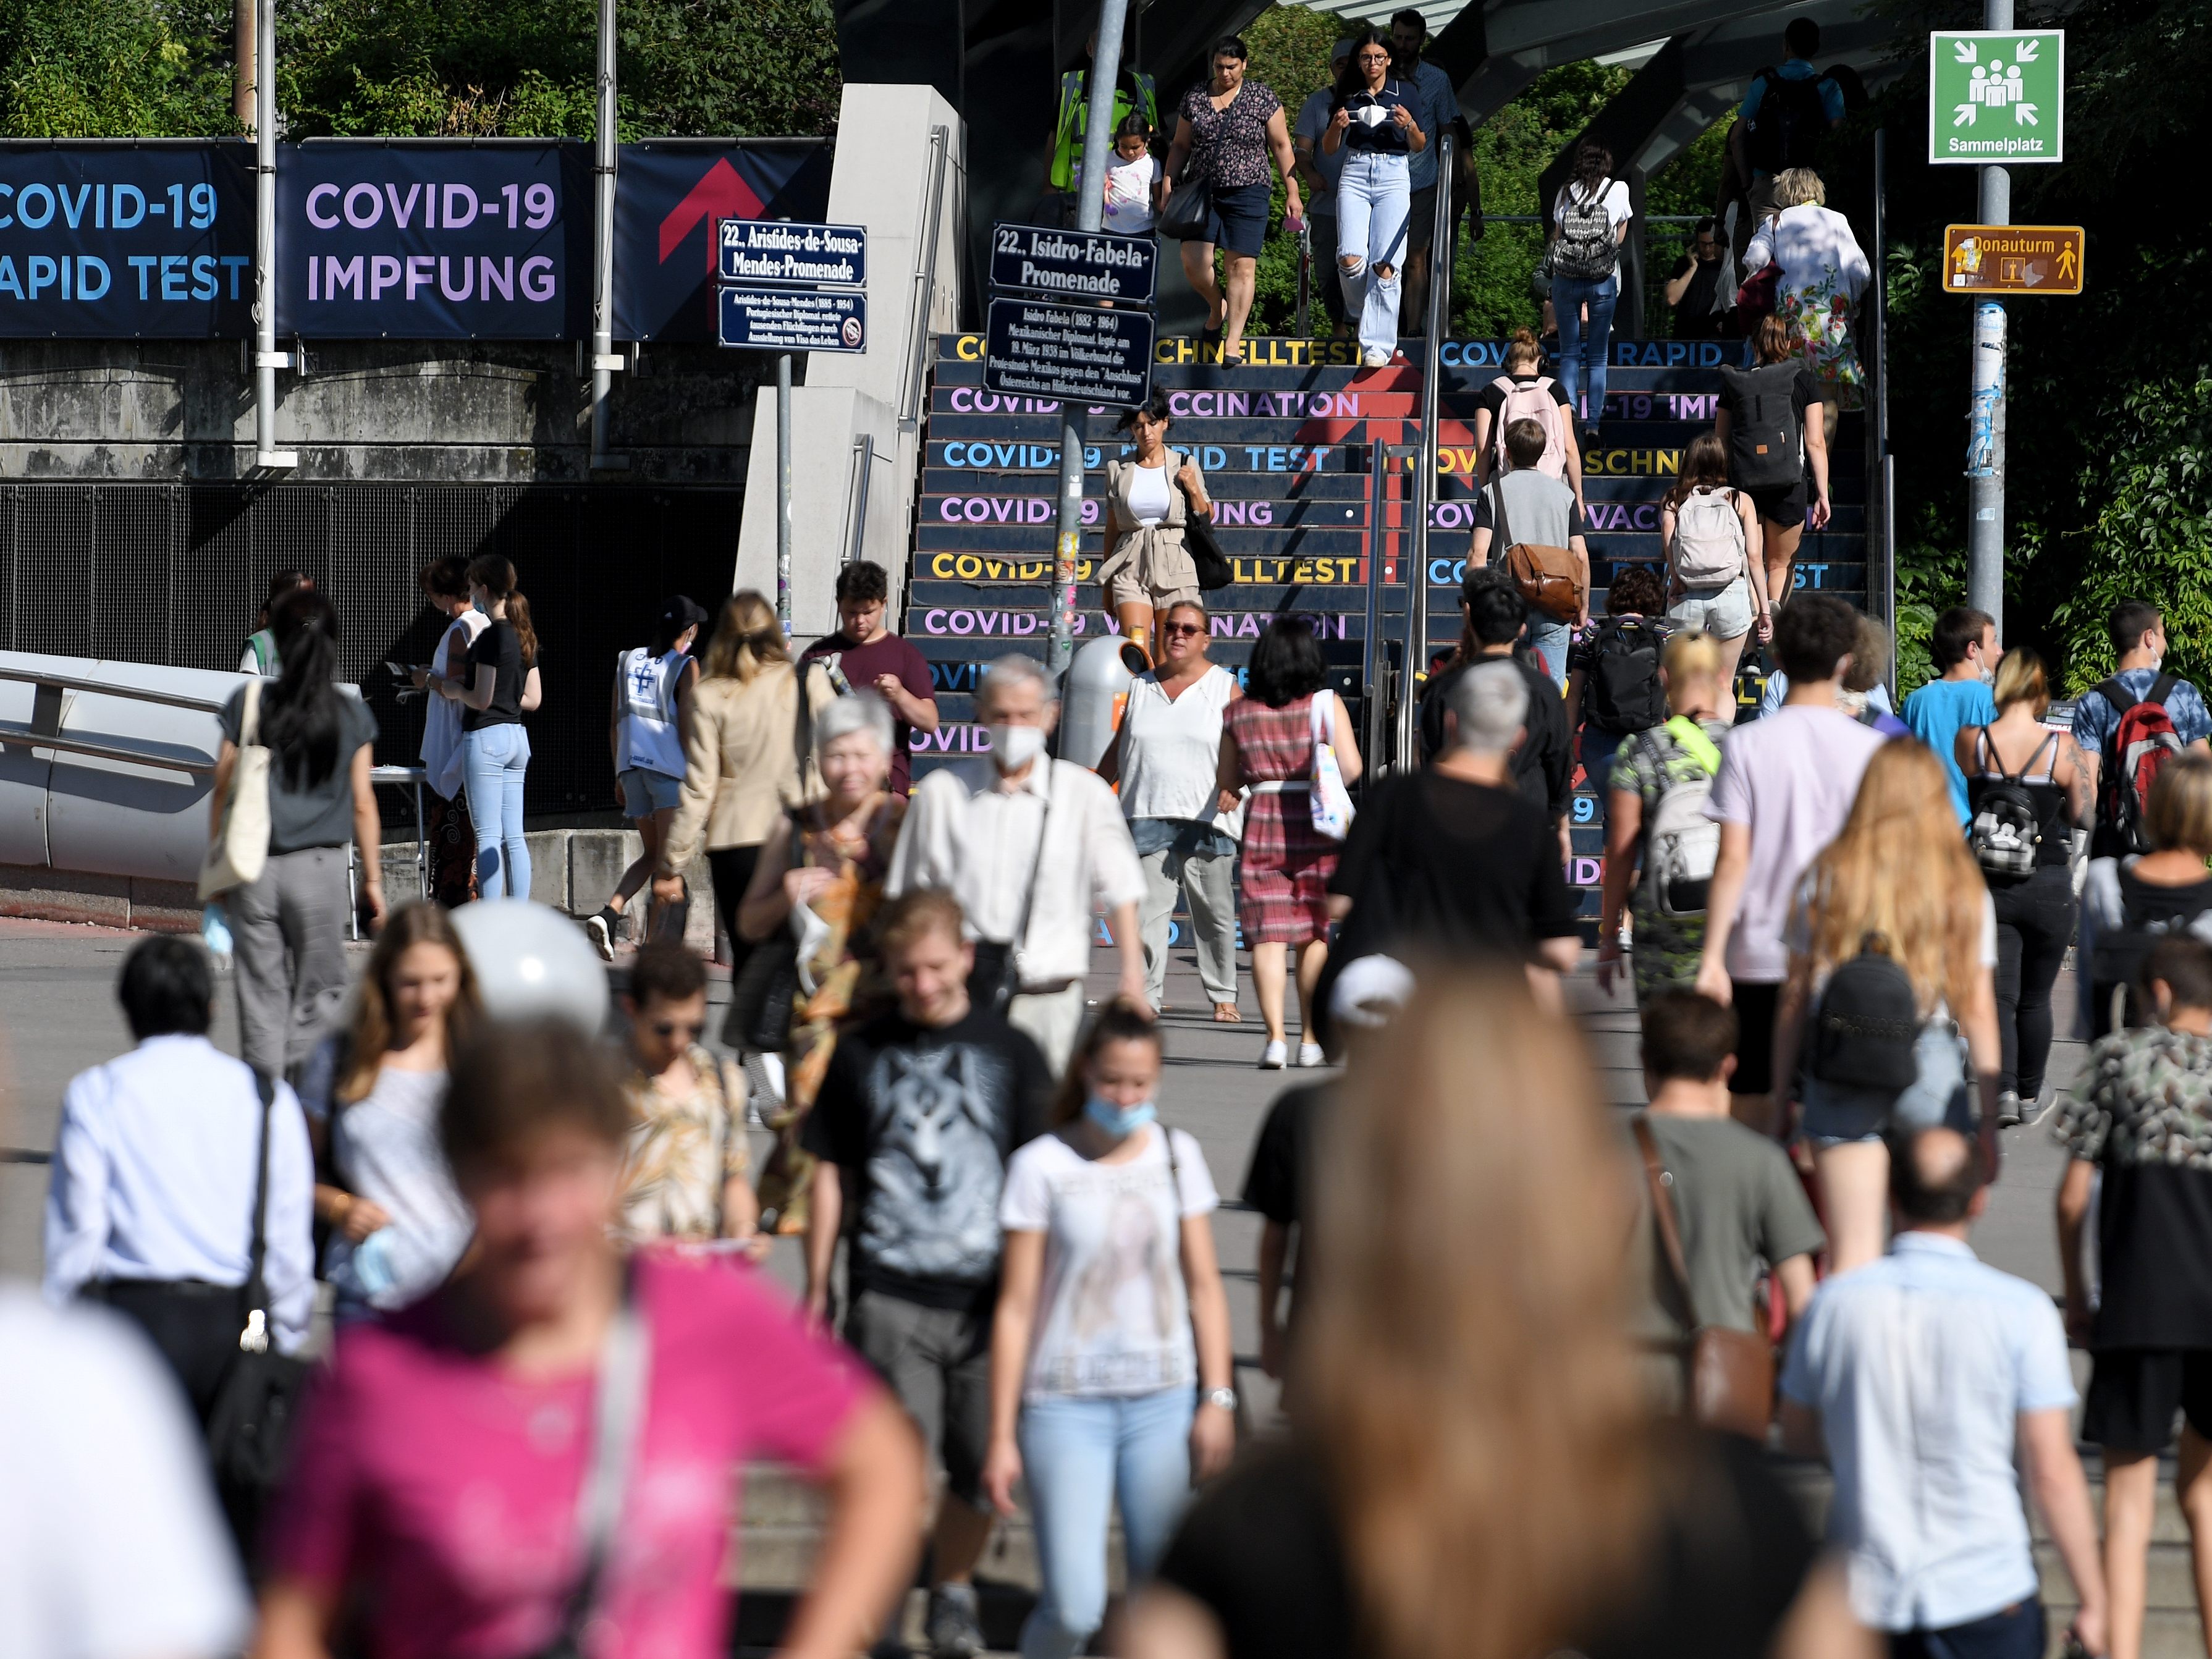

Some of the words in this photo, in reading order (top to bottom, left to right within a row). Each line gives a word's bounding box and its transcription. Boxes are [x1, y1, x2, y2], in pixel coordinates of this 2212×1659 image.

[1949, 137, 2043, 154] Sammelplatz
[306, 182, 555, 229] COVID-19
[747, 225, 863, 254] Aristides-de-Sousa-
[1030, 233, 1150, 268] Isidro-Fabela-
[1973, 236, 2054, 253] Donauturm
[0, 255, 111, 300] APID
[128, 255, 249, 300] TEST
[308, 255, 555, 302] IMPFUNG
[732, 251, 855, 281] Mendes-Promenade
[1021, 260, 1121, 294] Promenade
[820, 322, 838, 333] durch
[1023, 308, 1045, 322] Isidro
[1045, 310, 1070, 325] Fabela
[783, 336, 796, 344] von
[796, 334, 809, 344] Visa
[809, 334, 821, 344] das
[821, 334, 840, 346] Leben
[1008, 323, 1062, 340] Mexikanischer
[1097, 332, 1117, 349] legte
[1117, 339, 1130, 348] am
[1011, 340, 1021, 353] 19.
[1022, 341, 1041, 355] März
[1041, 344, 1058, 357] 1938
[1058, 346, 1070, 358] im
[1070, 346, 1112, 363] Völkerbund
[1112, 350, 1125, 365] die
[1617, 342, 1723, 367] RAPID
[989, 355, 1030, 371] Protestnote
[1030, 359, 1060, 374] Mexikos
[1060, 366, 1084, 380] gegen
[1084, 365, 1100, 379] den
[1000, 371, 1041, 389] Österreichs
[1041, 381, 1051, 390] an
[1052, 378, 1117, 397] Hitlerdeutschland
[1117, 389, 1132, 400] vor.
[1168, 392, 1359, 418] CCINATION
[943, 442, 1101, 469] COVID-9
[1246, 447, 1329, 471] TEST
[932, 553, 1092, 580] COVID-9
[925, 609, 1086, 635] COVID-9
